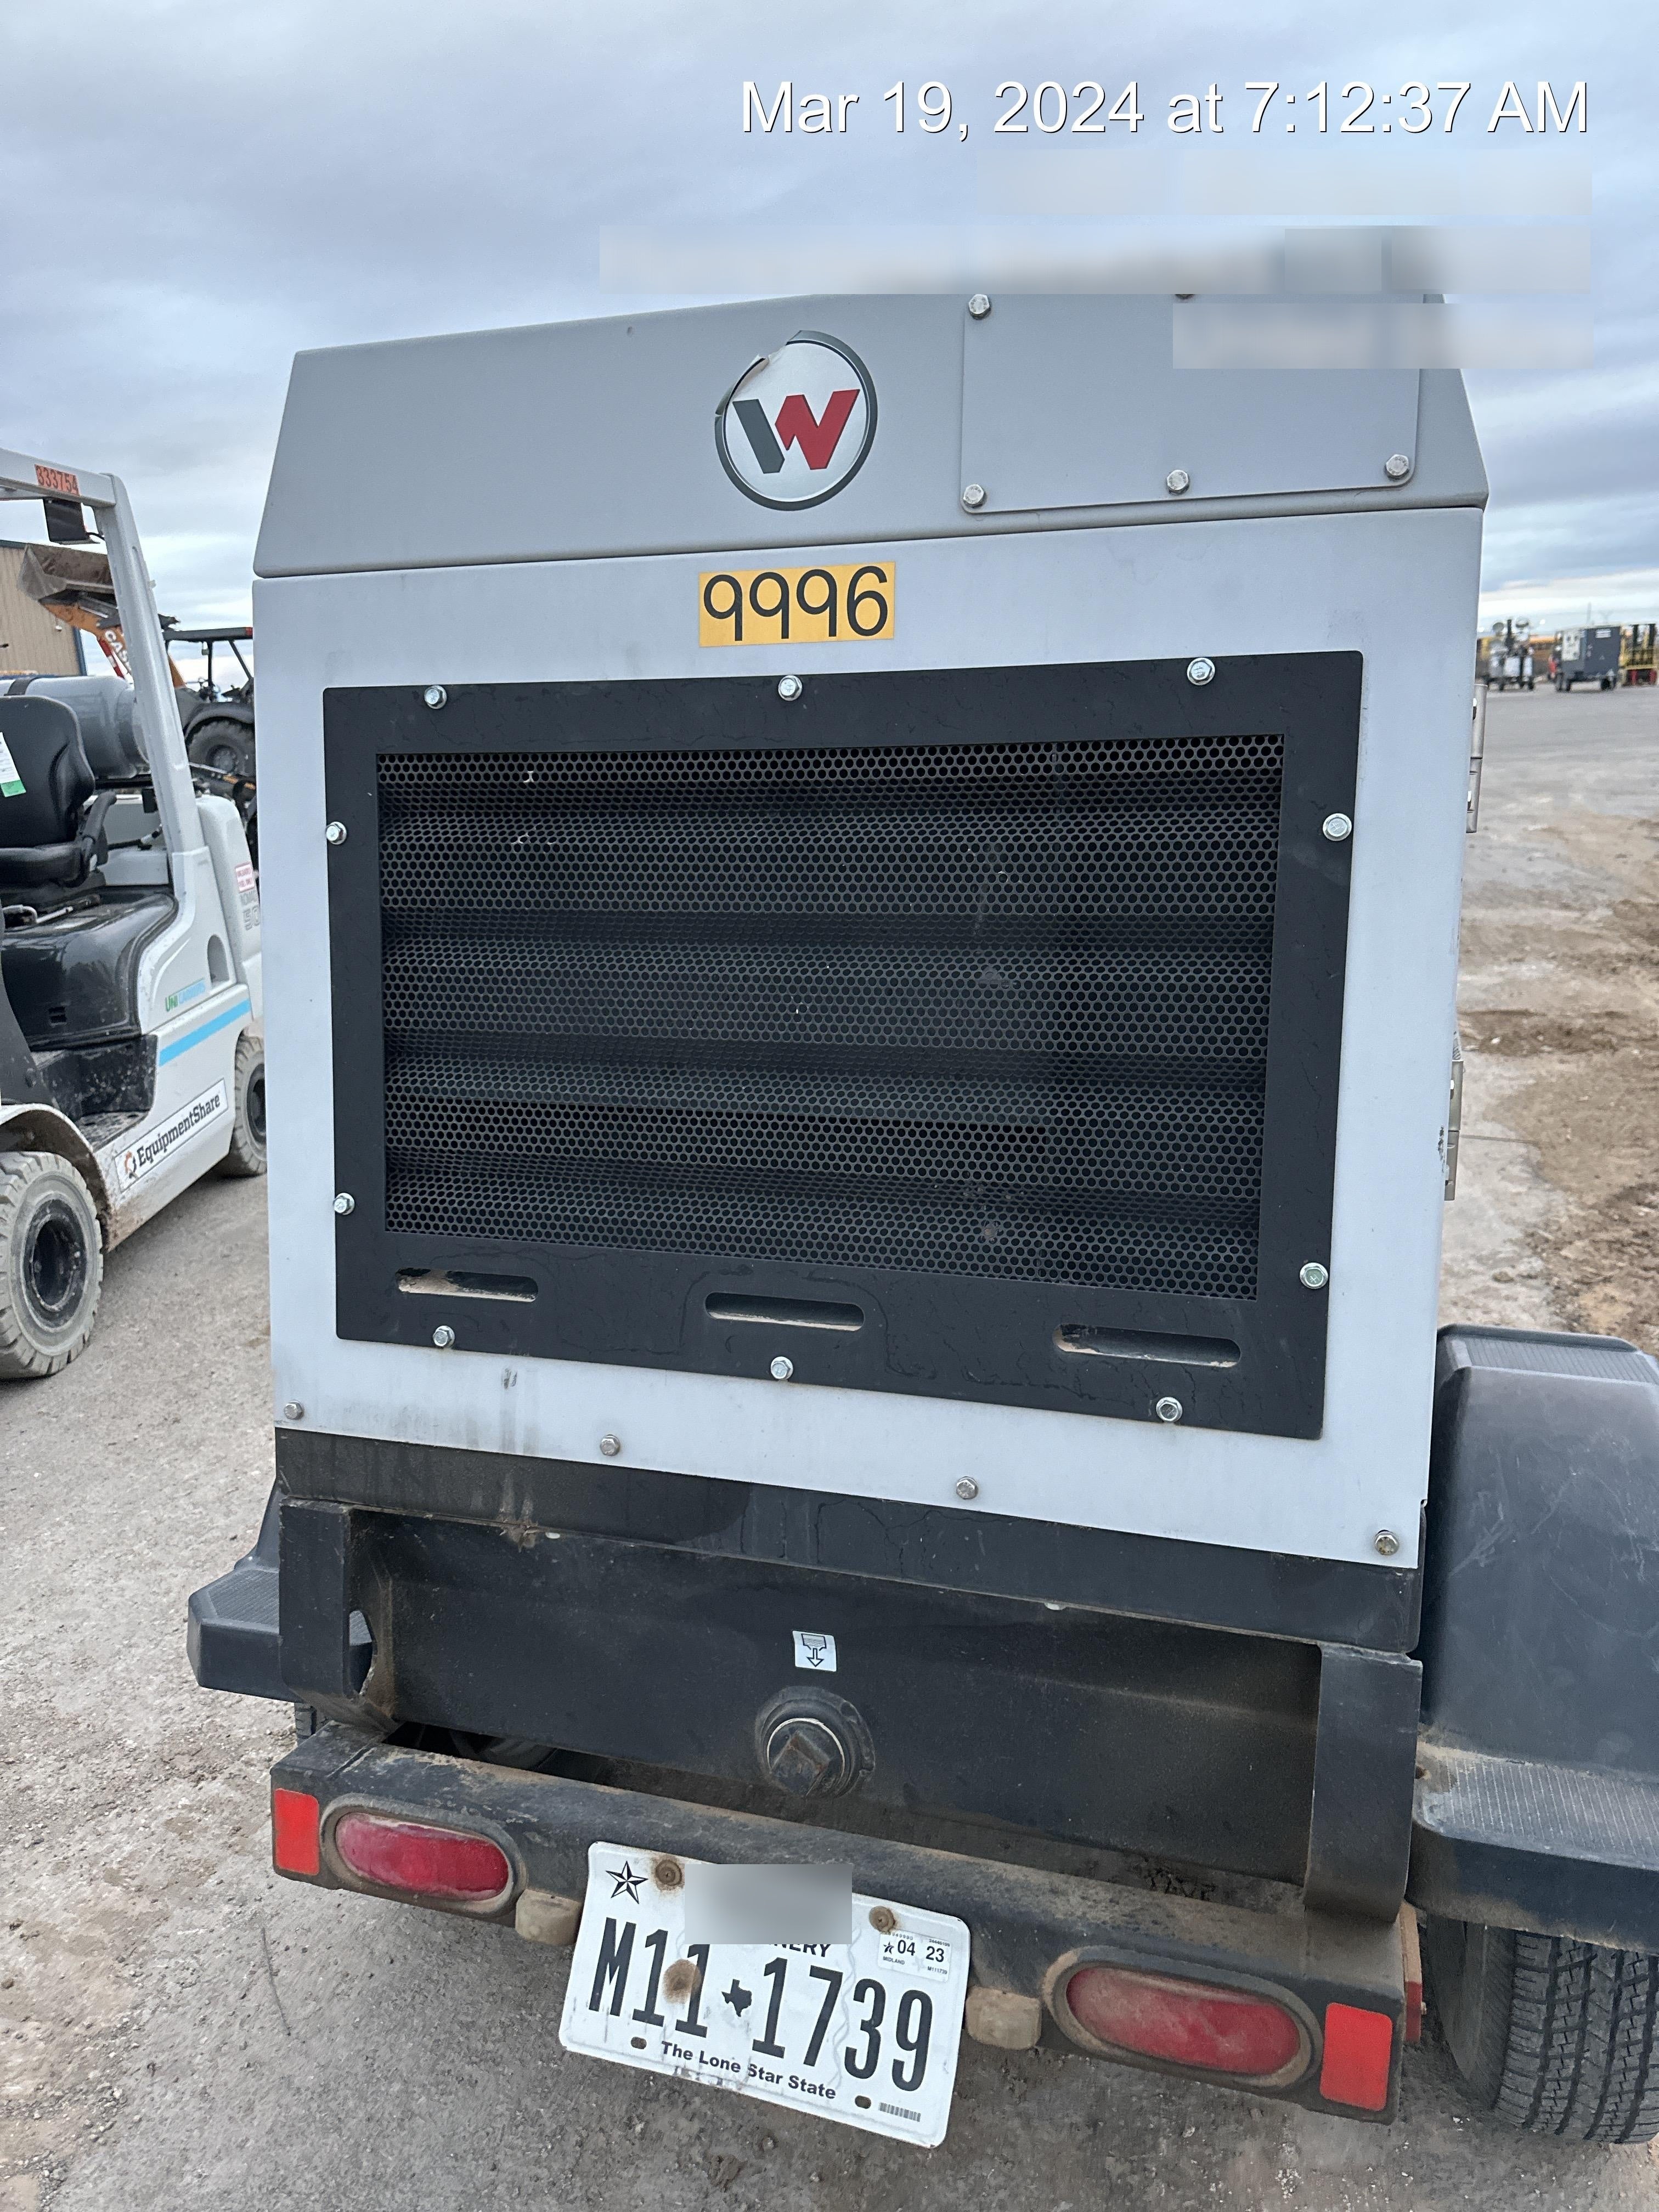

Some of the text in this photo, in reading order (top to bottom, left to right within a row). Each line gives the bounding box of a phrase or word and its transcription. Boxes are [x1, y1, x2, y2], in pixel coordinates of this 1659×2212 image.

[36, 466, 80, 496] 333754
[703, 566, 888, 642] 9996
[137, 1094, 221, 1167] EquipmentShare
[882, 1956, 905, 1965] MIDLAND
[897, 1939, 945, 1963] 04 23
[588, 1917, 933, 2092] M11 1739
[661, 2040, 837, 2100] The Lone Star State
